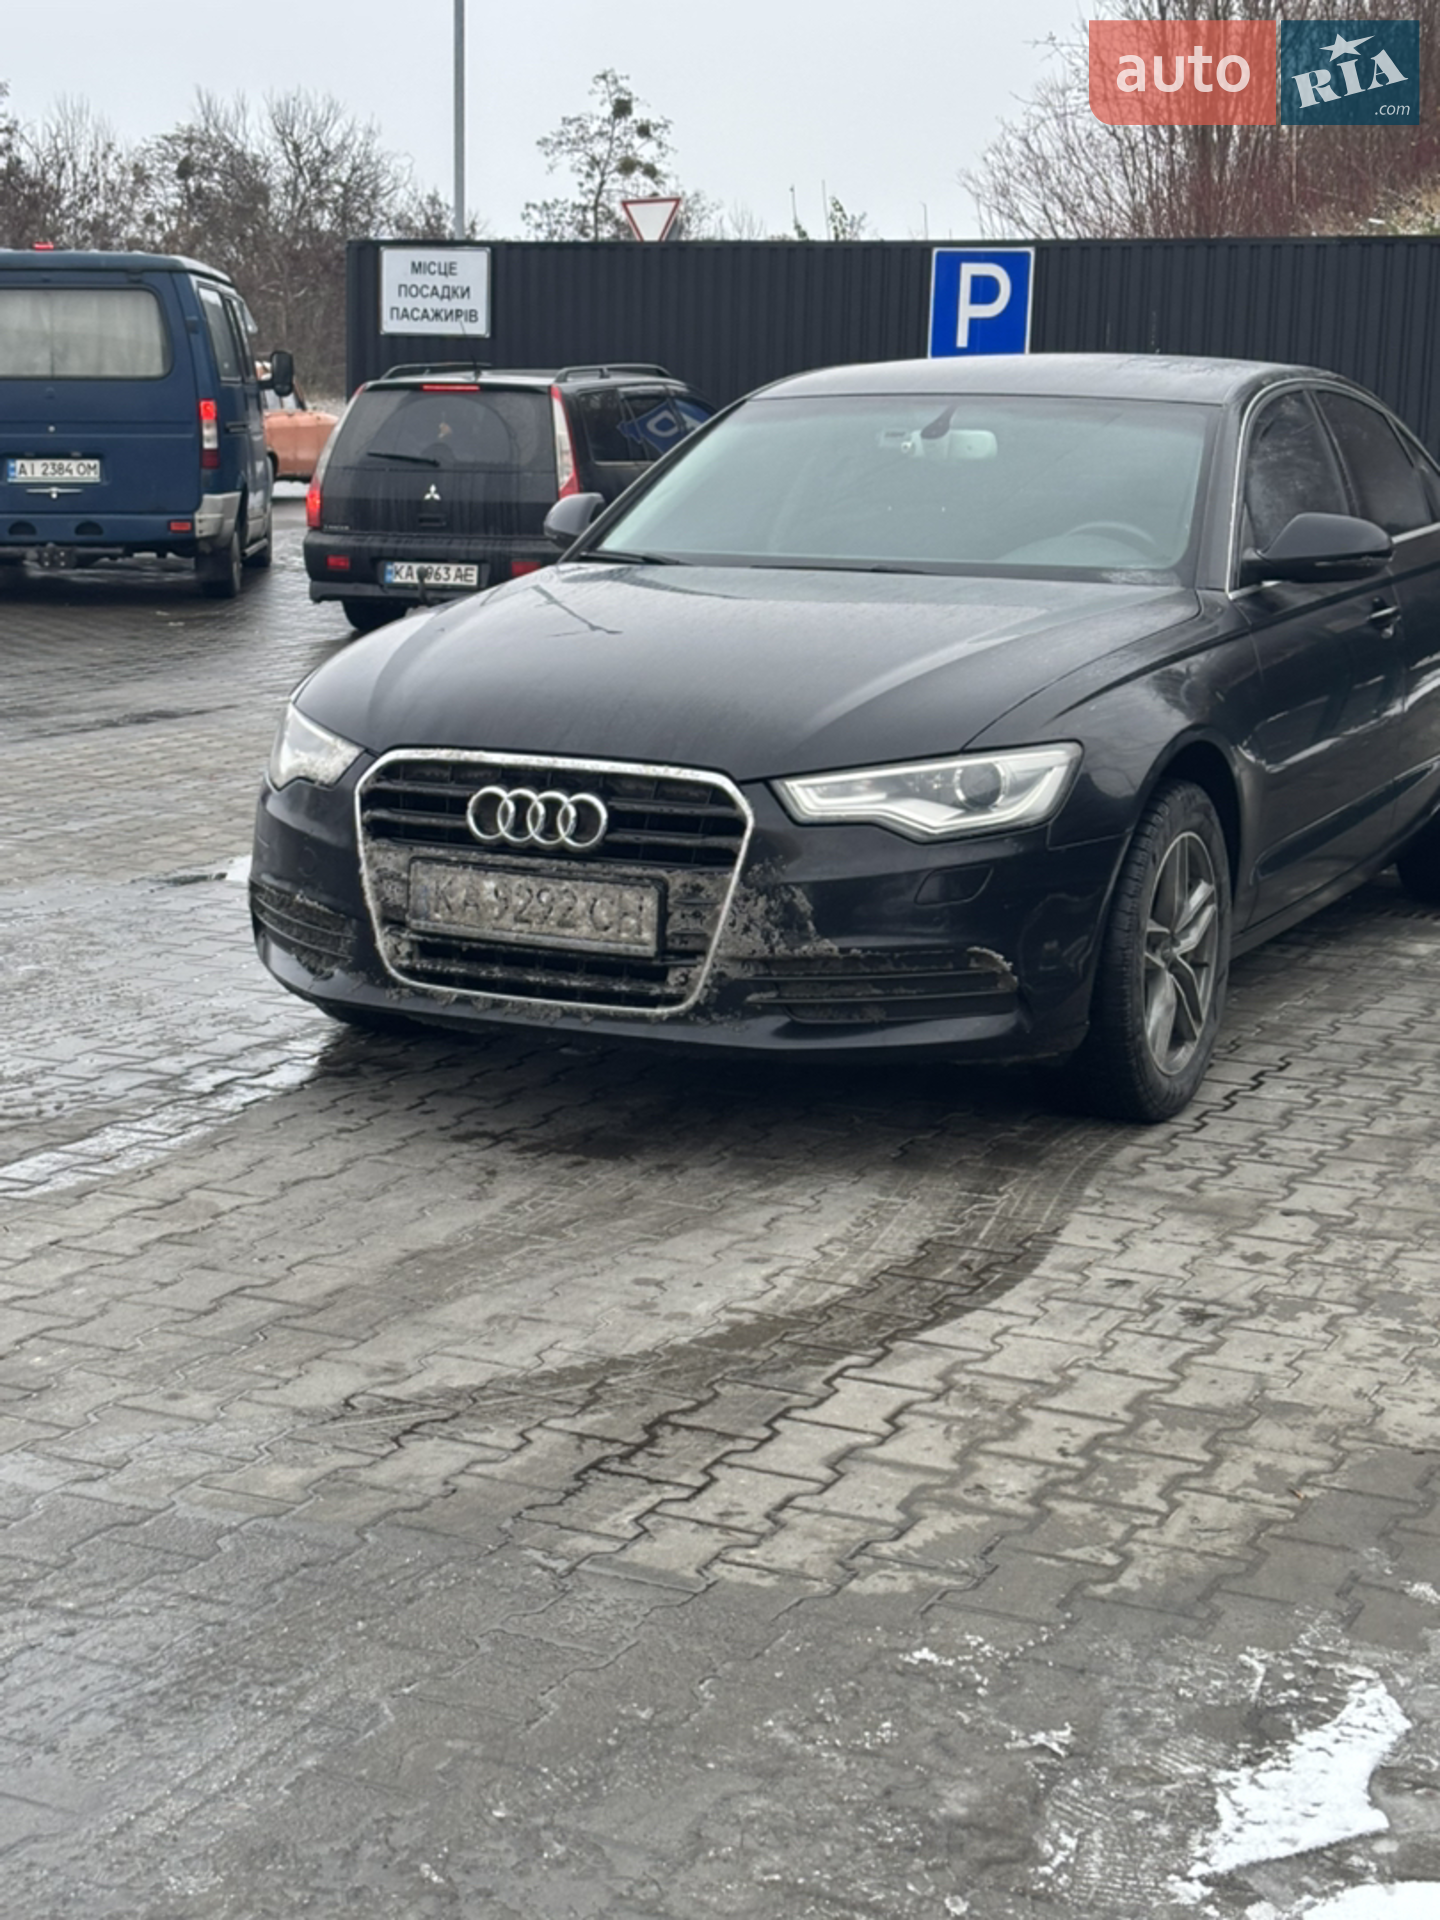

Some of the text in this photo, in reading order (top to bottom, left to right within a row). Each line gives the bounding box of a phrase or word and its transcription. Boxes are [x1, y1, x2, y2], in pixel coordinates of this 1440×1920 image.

[410, 261, 458, 278] МІСЦЕ
[398, 284, 471, 301] ПОСАДКИ
[956, 262, 1011, 348] P
[389, 306, 479, 323] ПАСАЖИРІВ
[41, 462, 74, 476] 2384
[452, 566, 476, 583] AE
